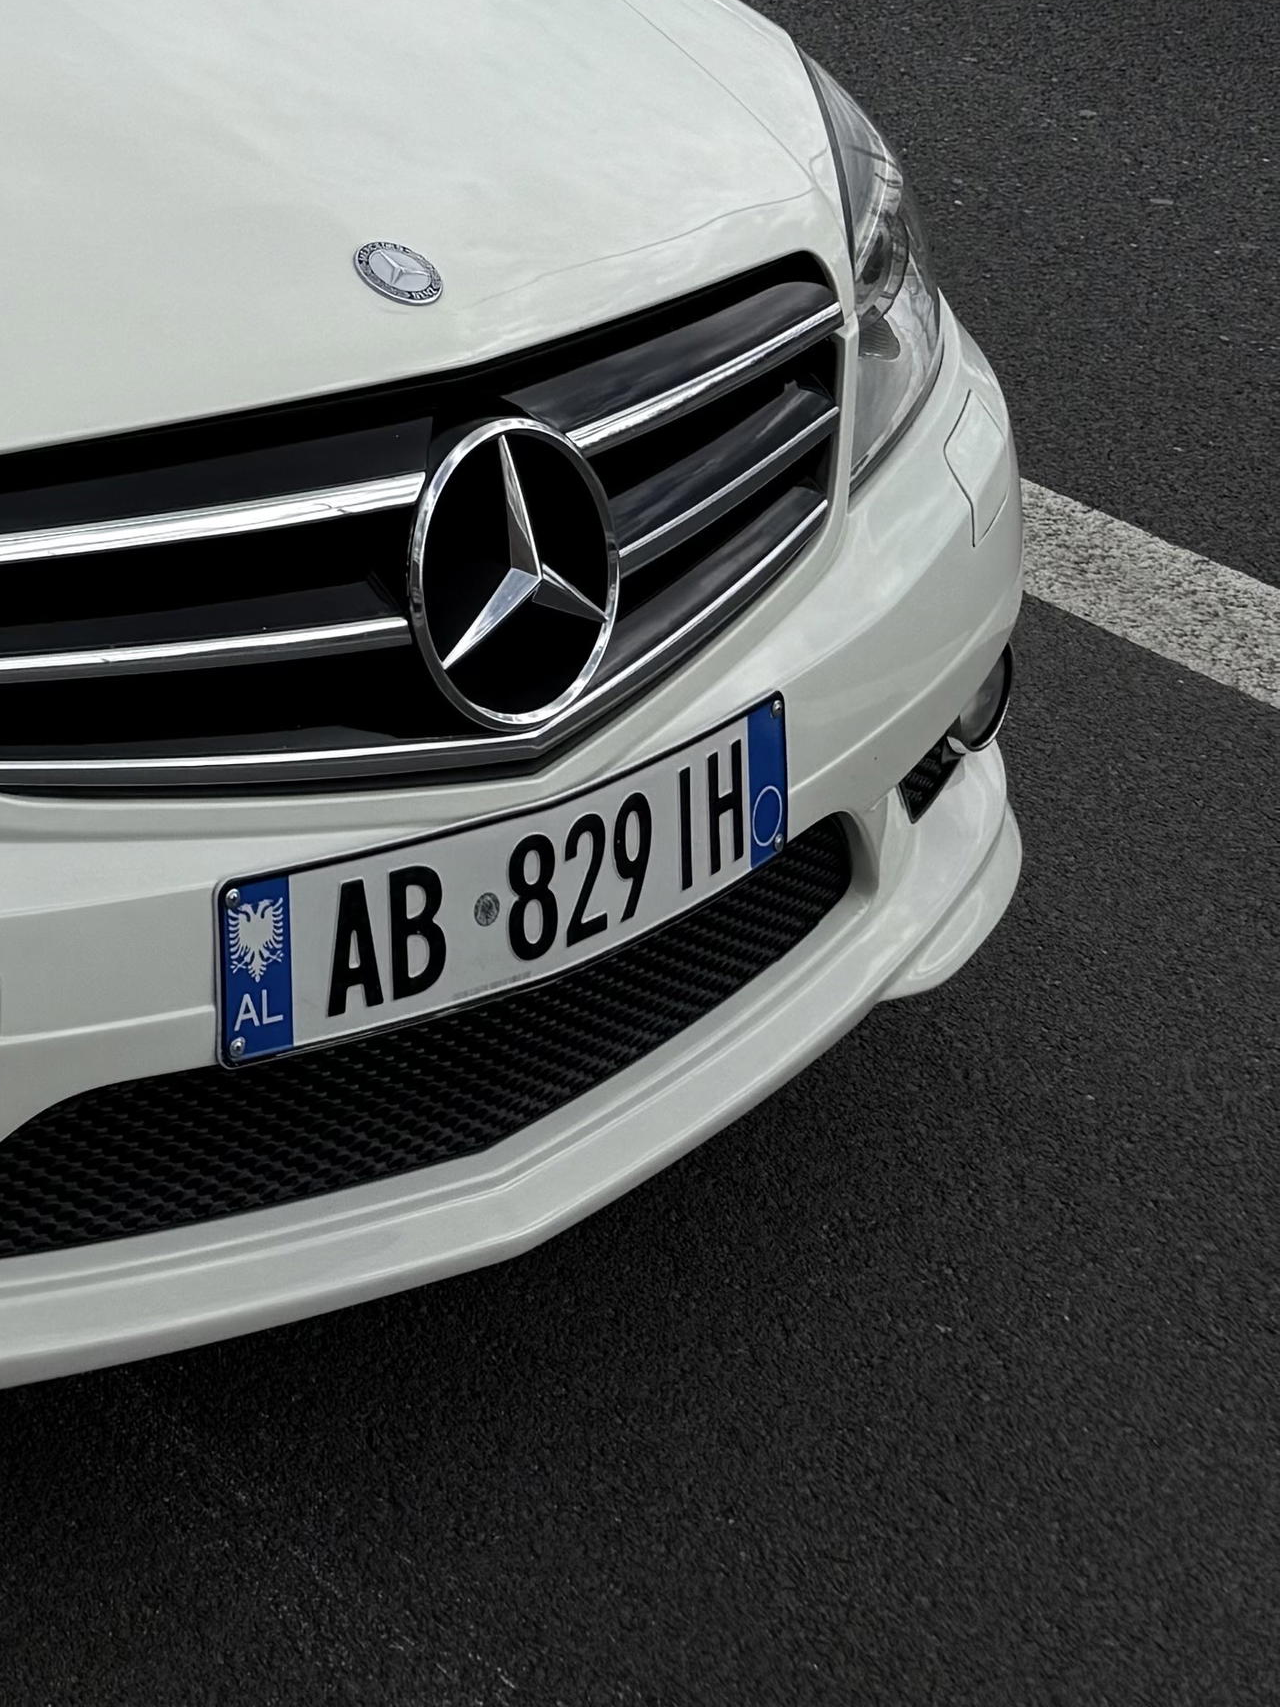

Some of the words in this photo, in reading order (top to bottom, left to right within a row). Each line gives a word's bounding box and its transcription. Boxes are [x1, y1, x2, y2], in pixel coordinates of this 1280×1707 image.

[326, 865, 447, 1018] AB
[507, 792, 653, 963] 829
[677, 738, 745, 891] IH
[234, 989, 284, 1032] AL
